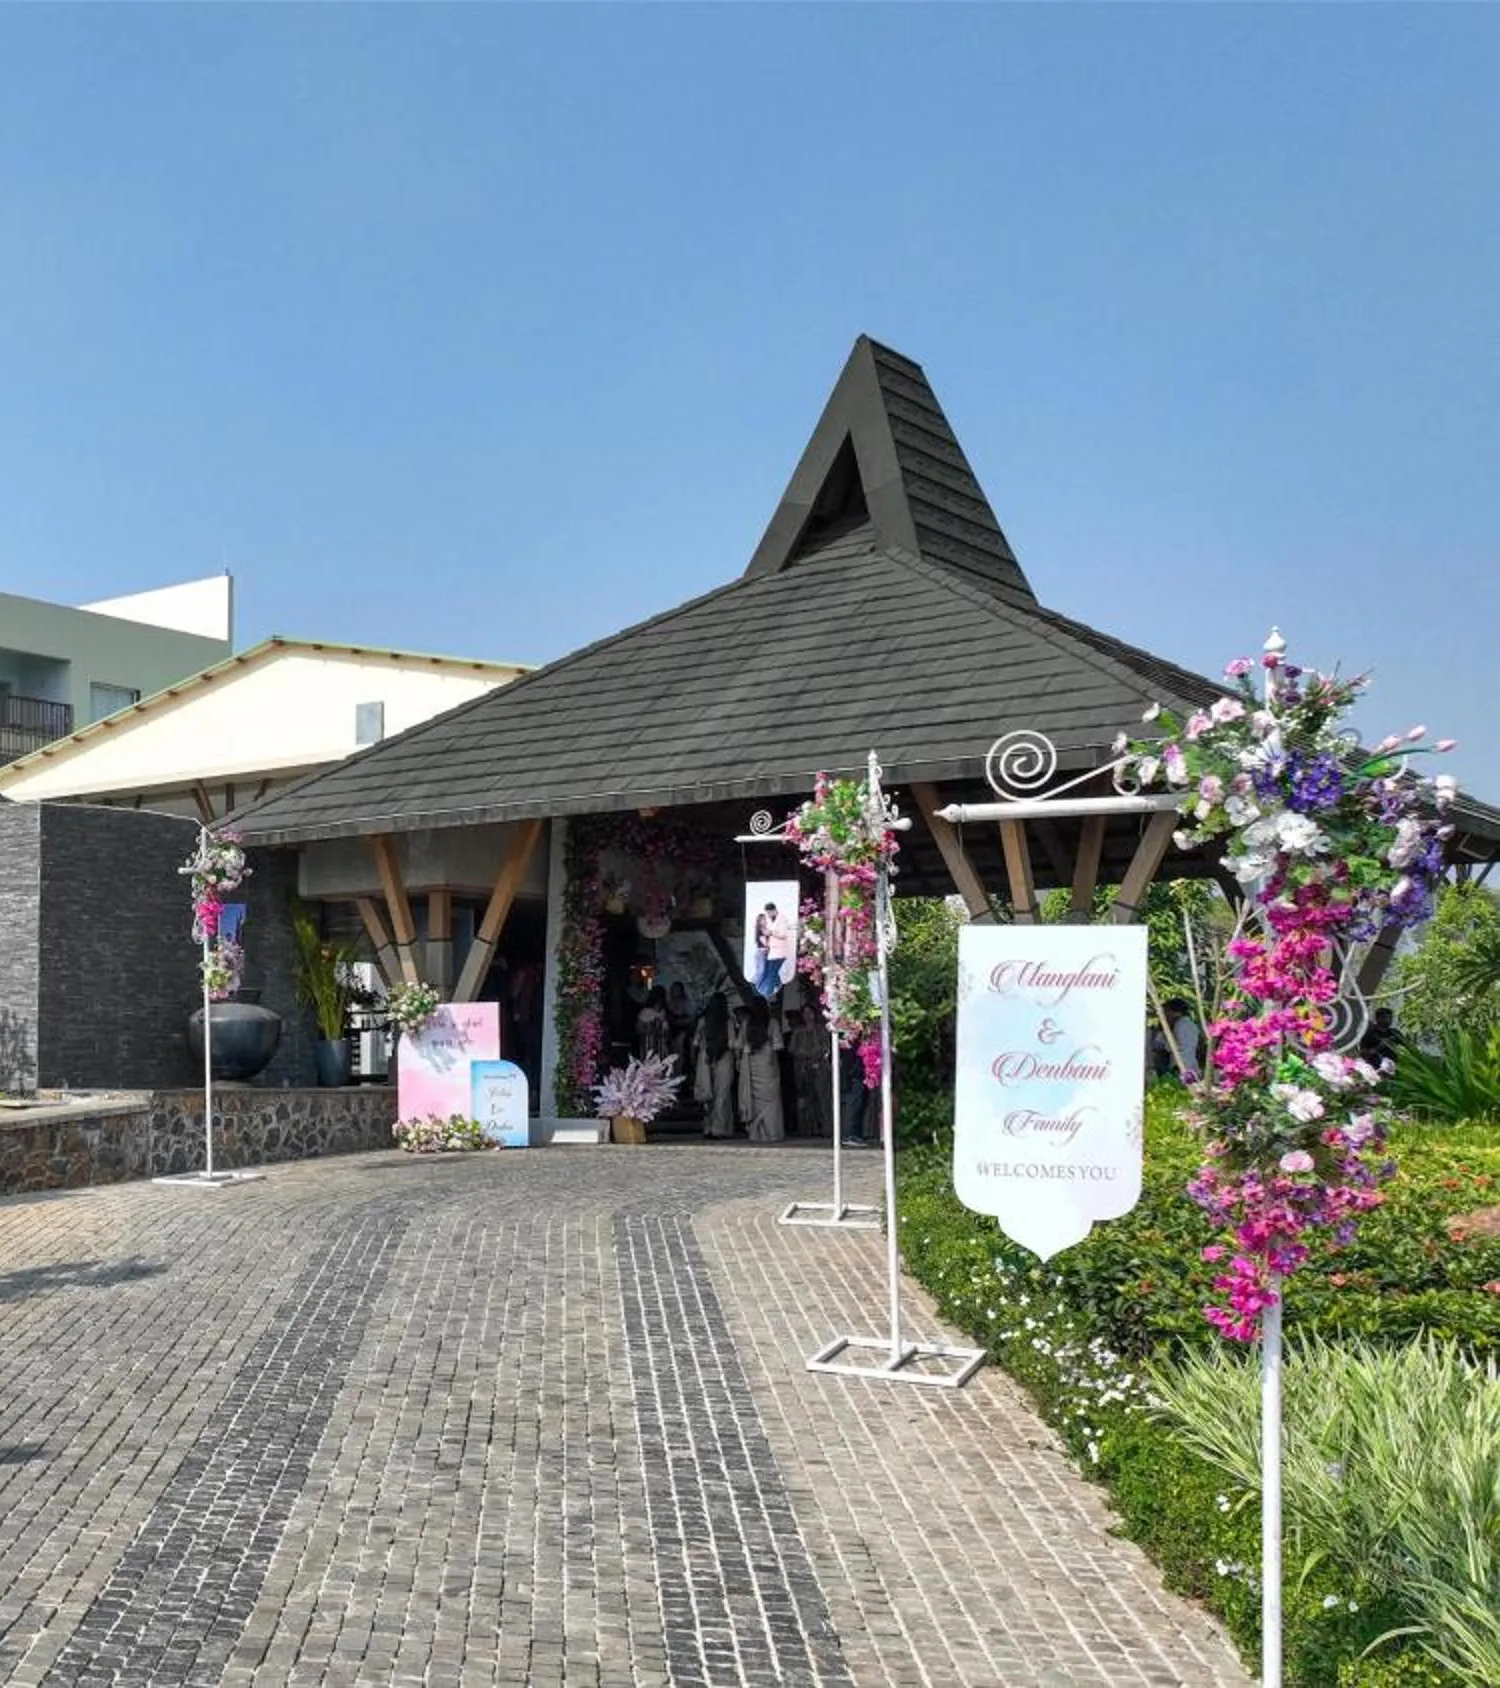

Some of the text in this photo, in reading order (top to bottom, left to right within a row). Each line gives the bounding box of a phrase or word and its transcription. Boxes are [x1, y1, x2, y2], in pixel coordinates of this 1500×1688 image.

[1037, 1017, 1065, 1045] &
[1003, 1105, 1097, 1146] Family
[977, 1161, 1117, 1181] WELCOMES YOU
